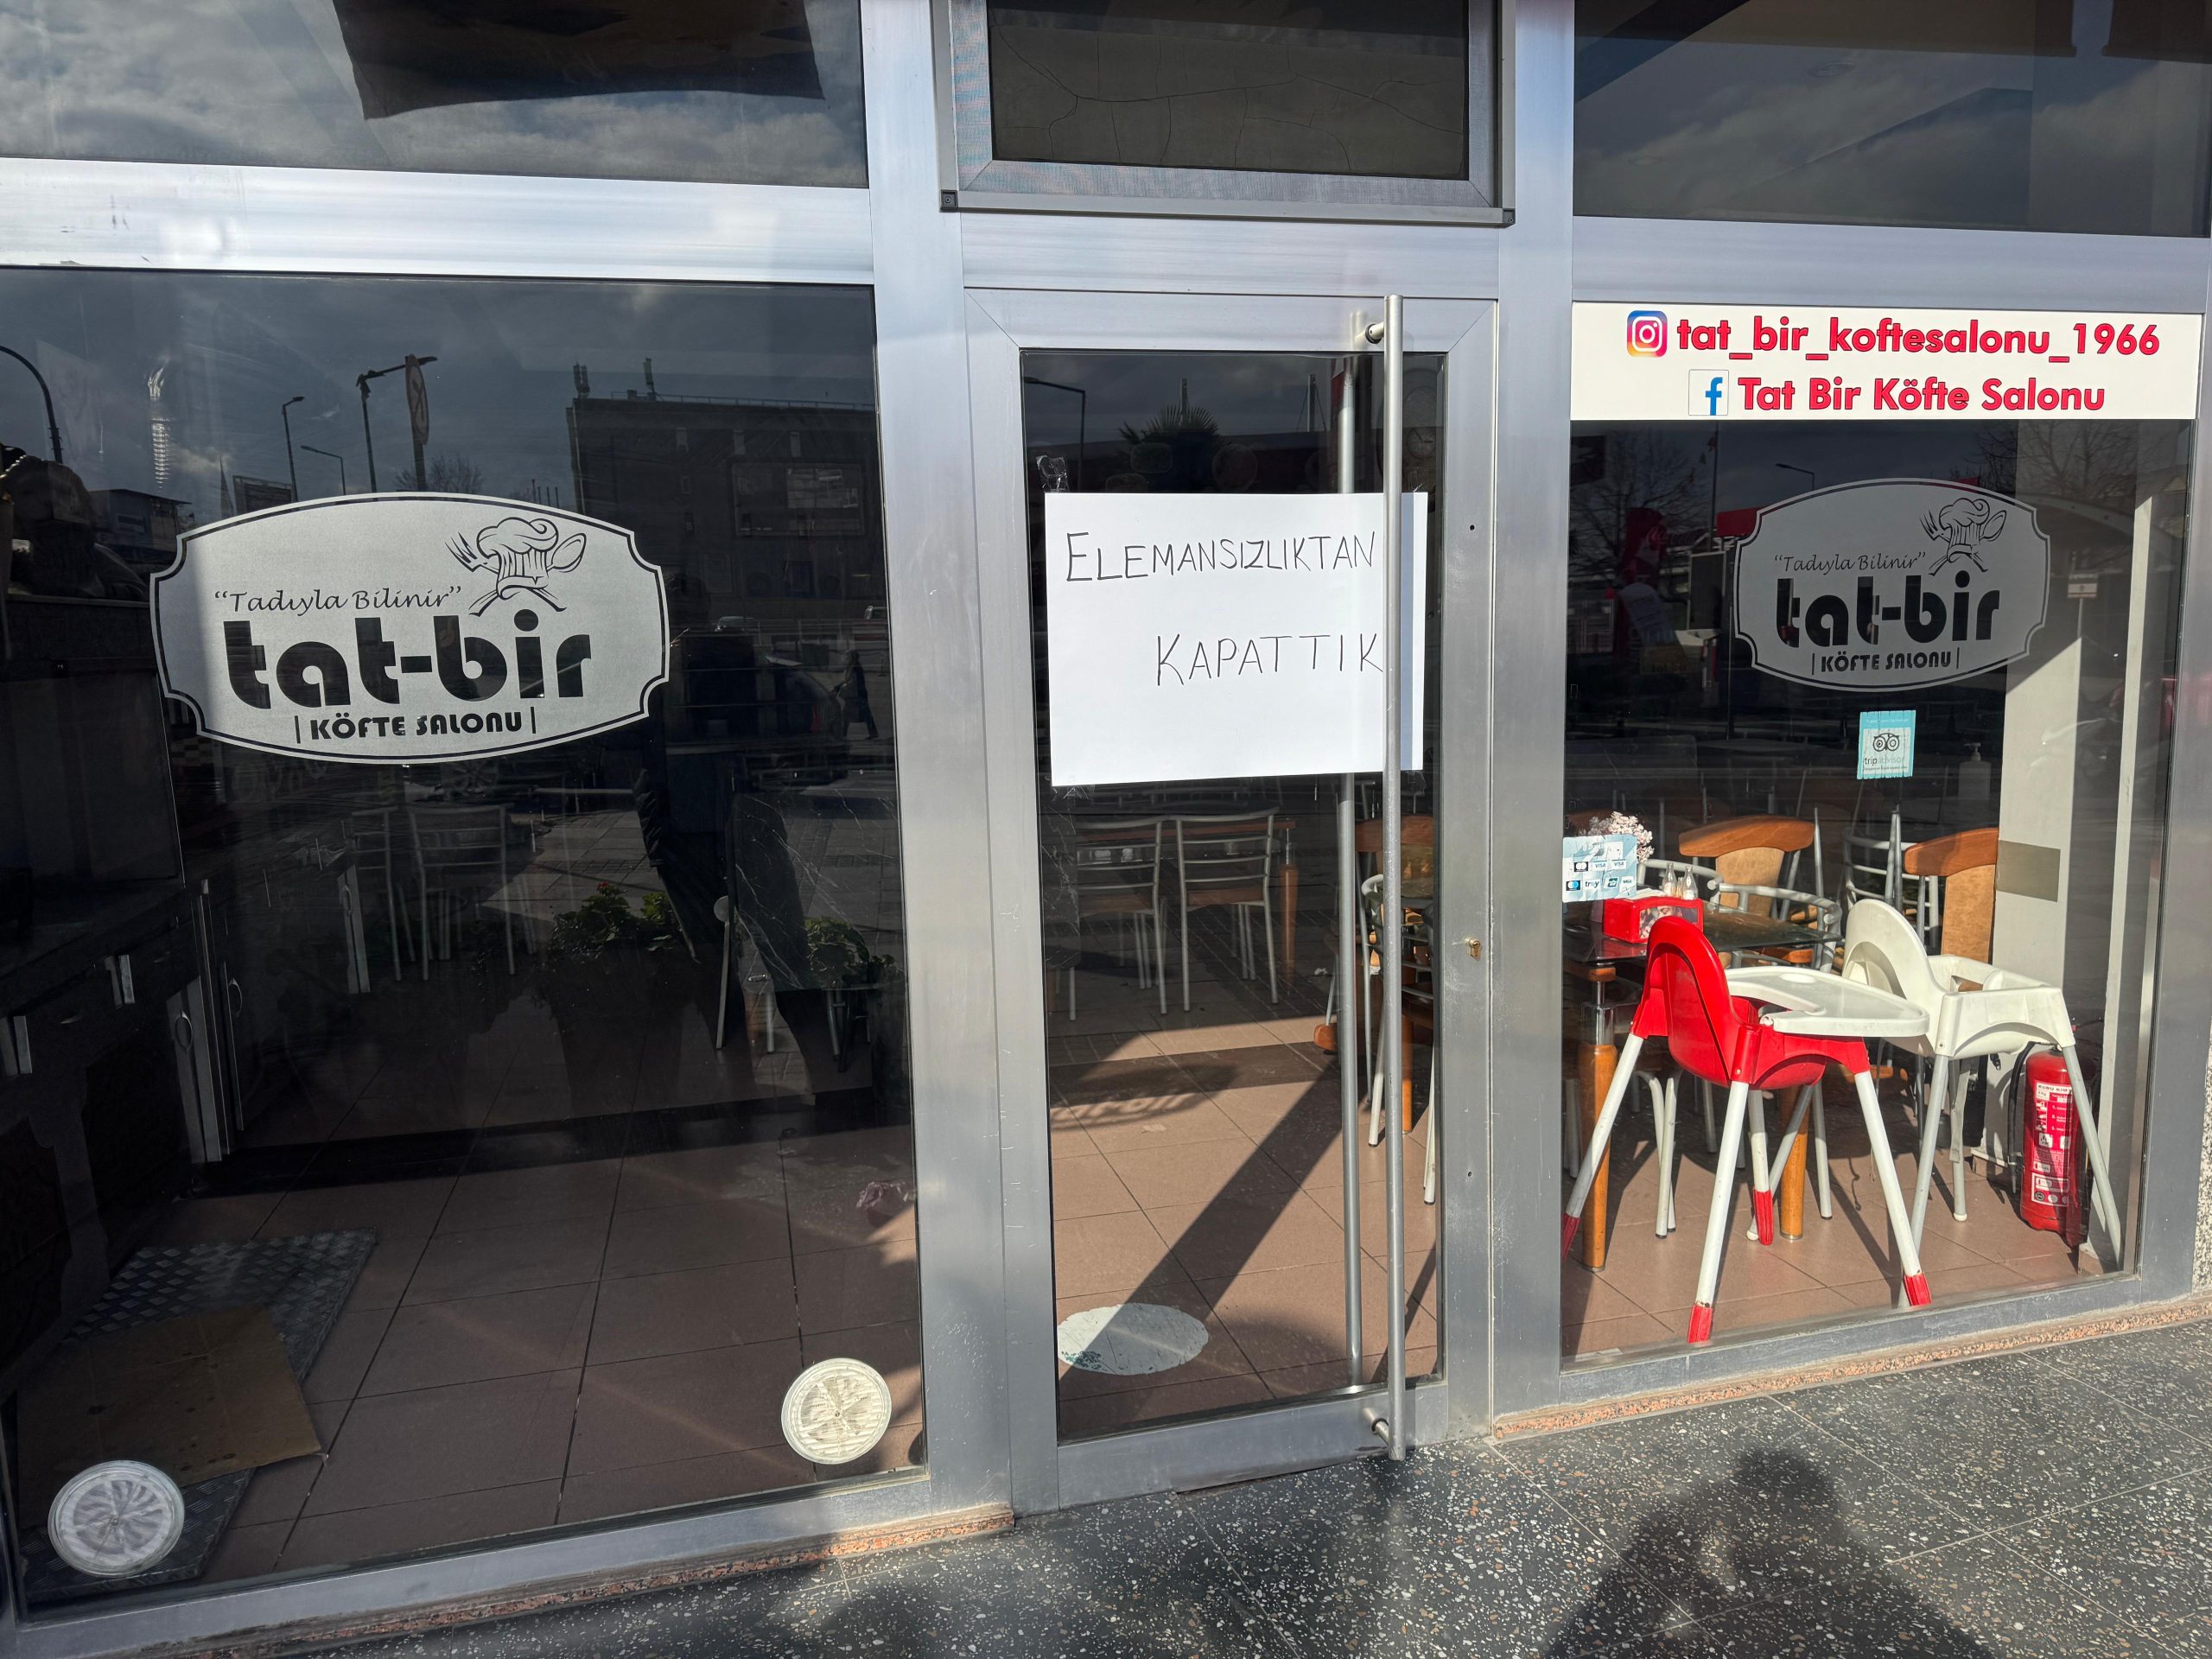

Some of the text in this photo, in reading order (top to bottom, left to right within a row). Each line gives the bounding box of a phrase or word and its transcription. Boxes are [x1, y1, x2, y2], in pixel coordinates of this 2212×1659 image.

[1677, 315, 2160, 363] tat_bir_koftesalonu_1966
[1738, 377, 1796, 410] Tat
[1808, 377, 1861, 410] Bir
[1873, 376, 1970, 411] Köfte
[1981, 377, 2106, 410] Salonu
[1065, 531, 1376, 582] ELEMANSIZLIKTAN
[1776, 569, 2000, 648] tat-bir
[223, 608, 592, 710] tat-bir
[1157, 633, 1382, 686] KAPATTIK
[1821, 651, 1952, 672] KÖFTE SALONU
[310, 711, 524, 741] KÖFTE SALONU
